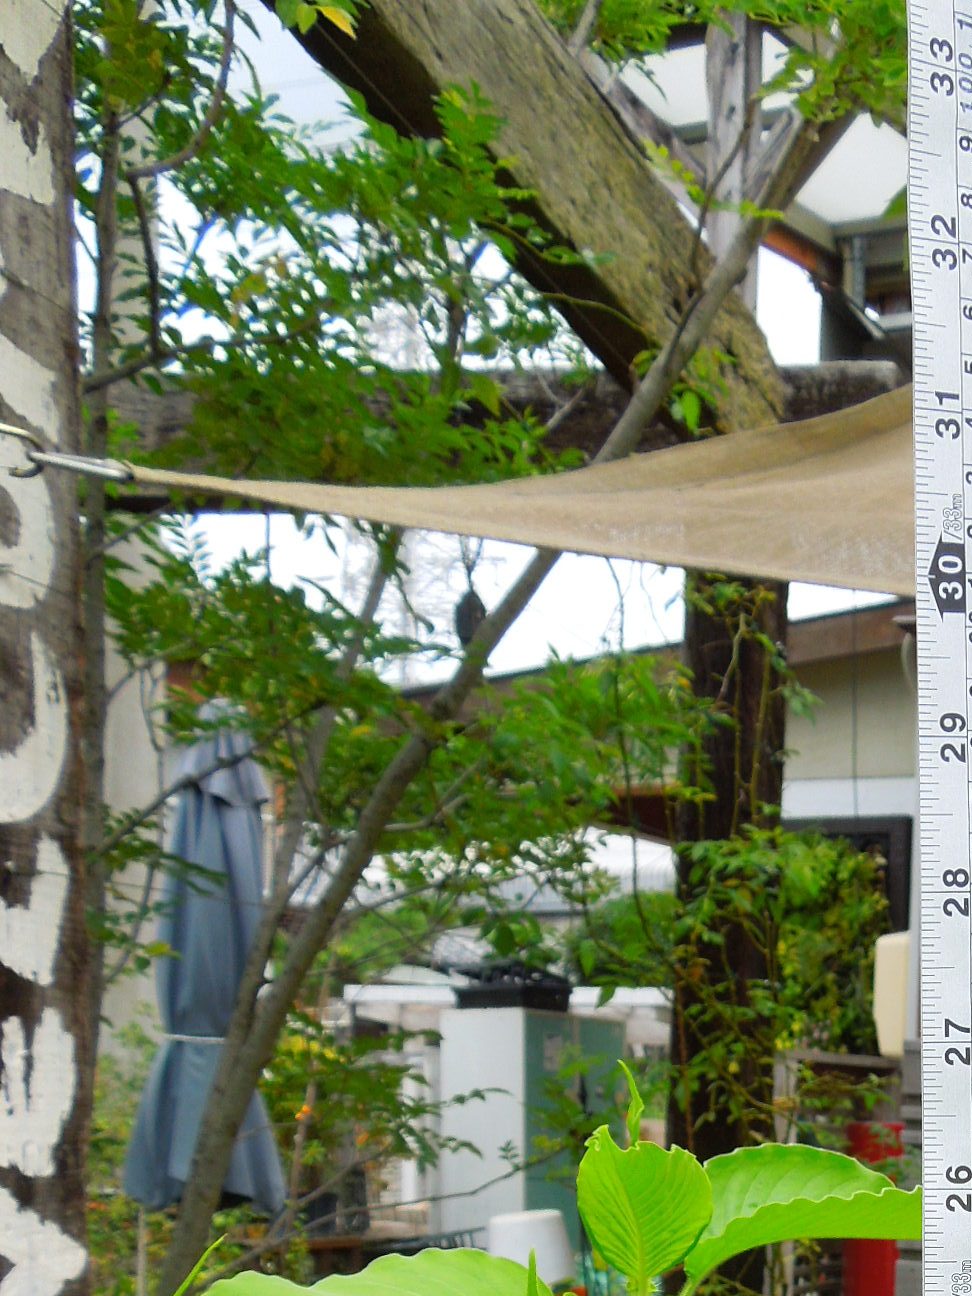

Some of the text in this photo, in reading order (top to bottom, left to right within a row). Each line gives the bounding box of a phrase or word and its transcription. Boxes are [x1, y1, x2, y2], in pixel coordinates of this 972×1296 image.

[957, 19, 972, 31] 1
[930, 37, 954, 96] 33
[930, 214, 957, 270] 32
[935, 391, 960, 440] 31
[938, 554, 964, 600] 30
[940, 712, 966, 763] 29
[943, 868, 969, 917] 28
[944, 1018, 970, 1066] 27
[946, 1166, 972, 1212] 26
